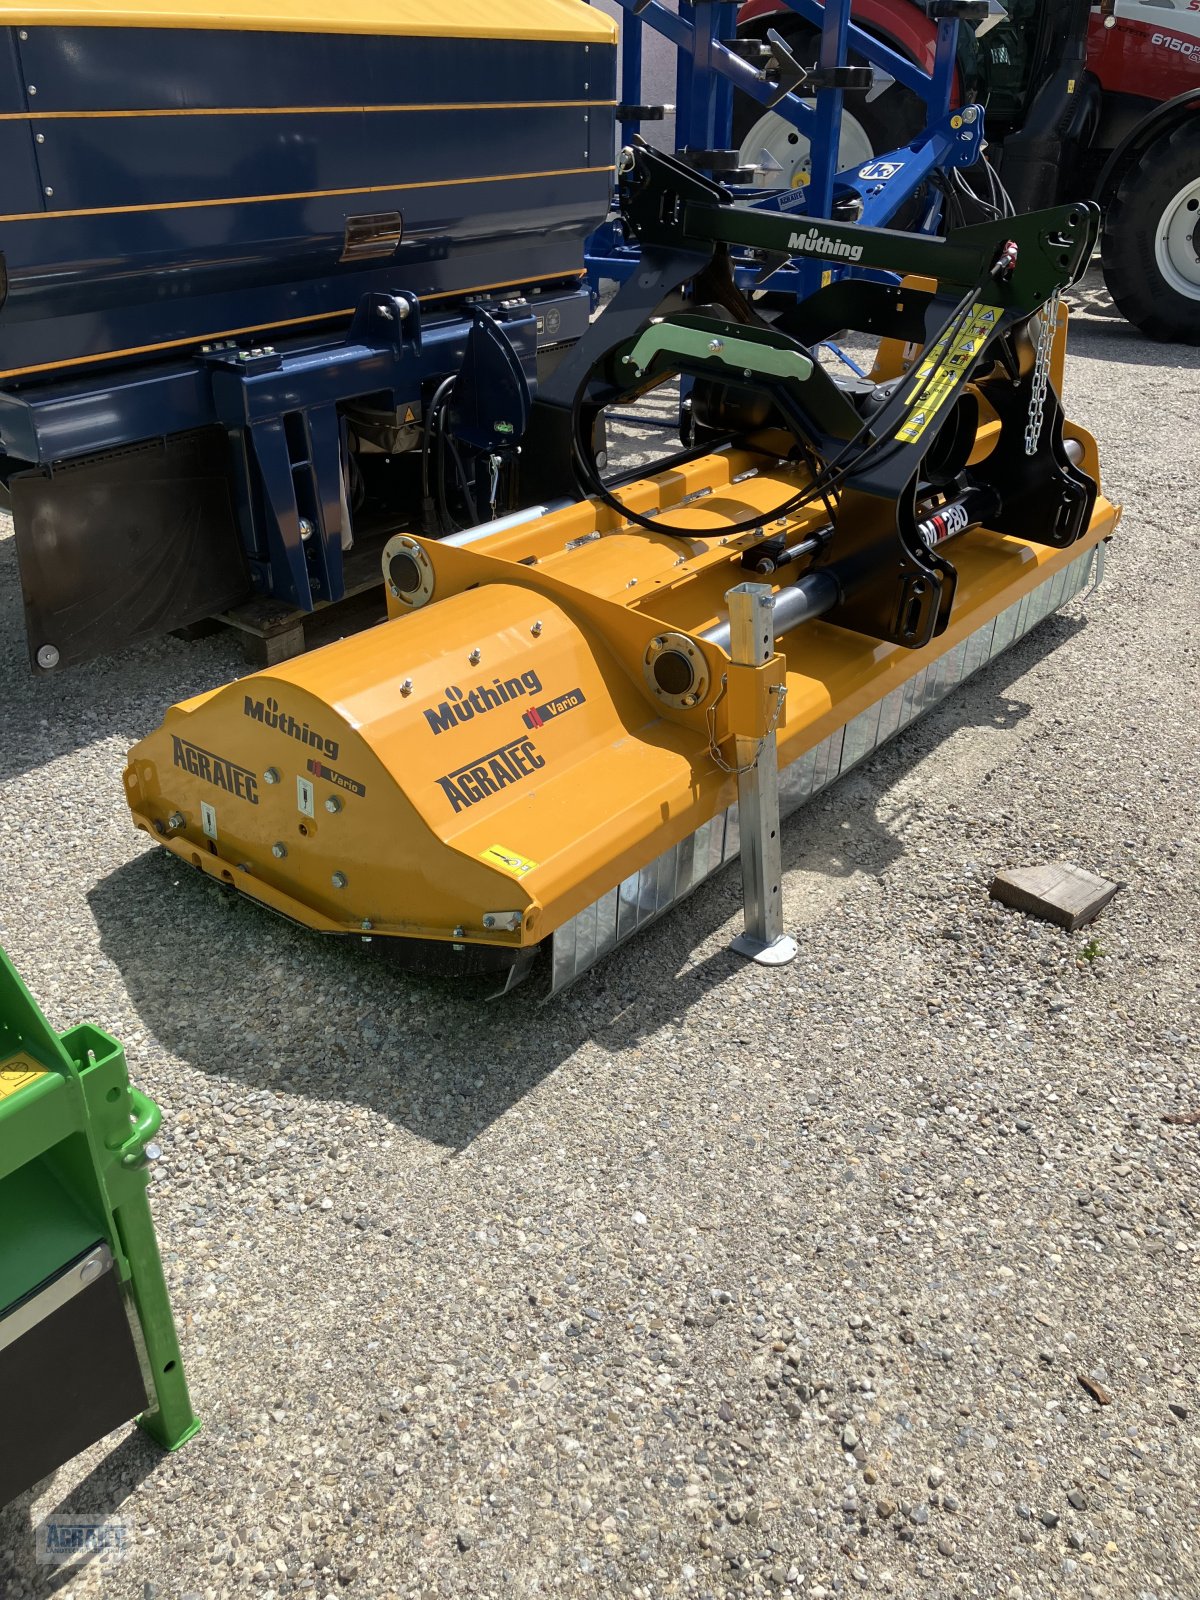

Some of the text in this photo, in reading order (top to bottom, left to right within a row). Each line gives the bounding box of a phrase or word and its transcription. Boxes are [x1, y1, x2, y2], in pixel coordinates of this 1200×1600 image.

[1151, 33, 1194, 55] 6150
[787, 227, 864, 261] Müthing
[941, 504, 969, 535] 280
[423, 669, 543, 736] Müthing
[546, 695, 579, 716] Vario
[243, 695, 339, 761] Müthing
[170, 733, 260, 805] AGRATEC
[329, 771, 358, 793] Vario
[434, 735, 546, 814] AGRATEC
